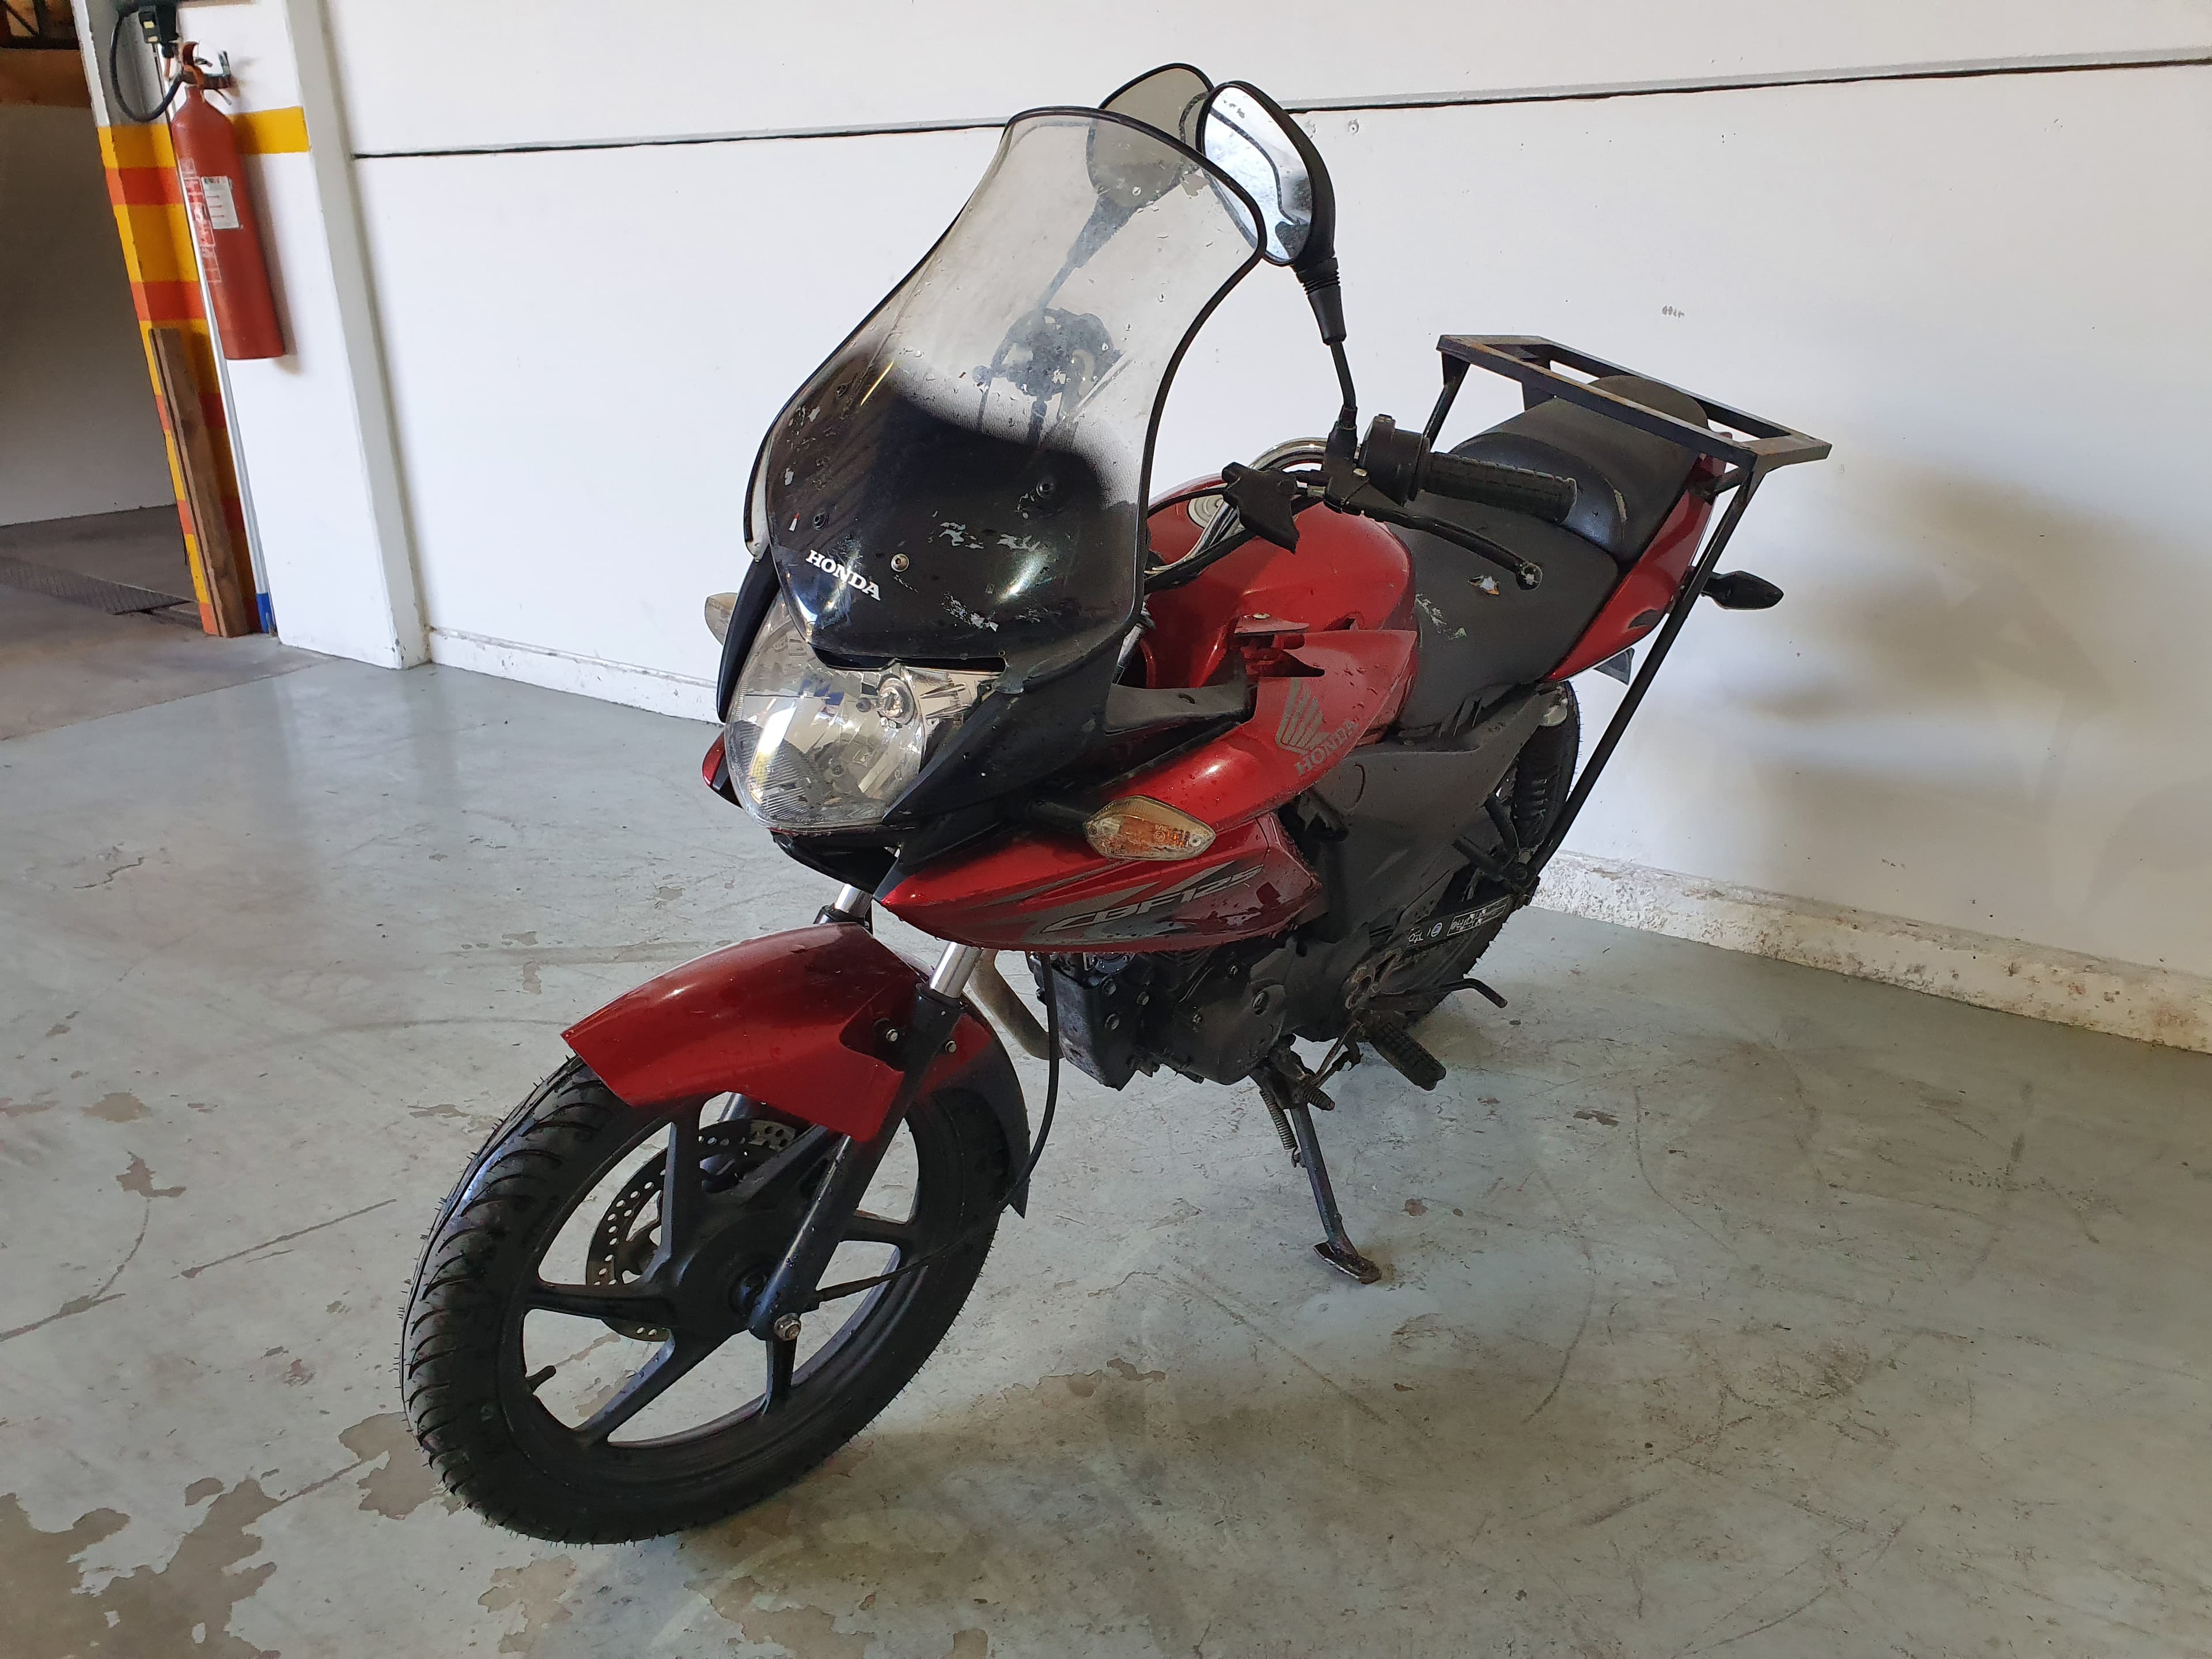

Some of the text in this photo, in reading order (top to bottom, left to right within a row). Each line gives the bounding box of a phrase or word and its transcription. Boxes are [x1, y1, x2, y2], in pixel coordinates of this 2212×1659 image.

[806, 550, 881, 601] HONDA
[1294, 719, 1359, 775] HONDA
[1039, 864, 1264, 934] CBF125
